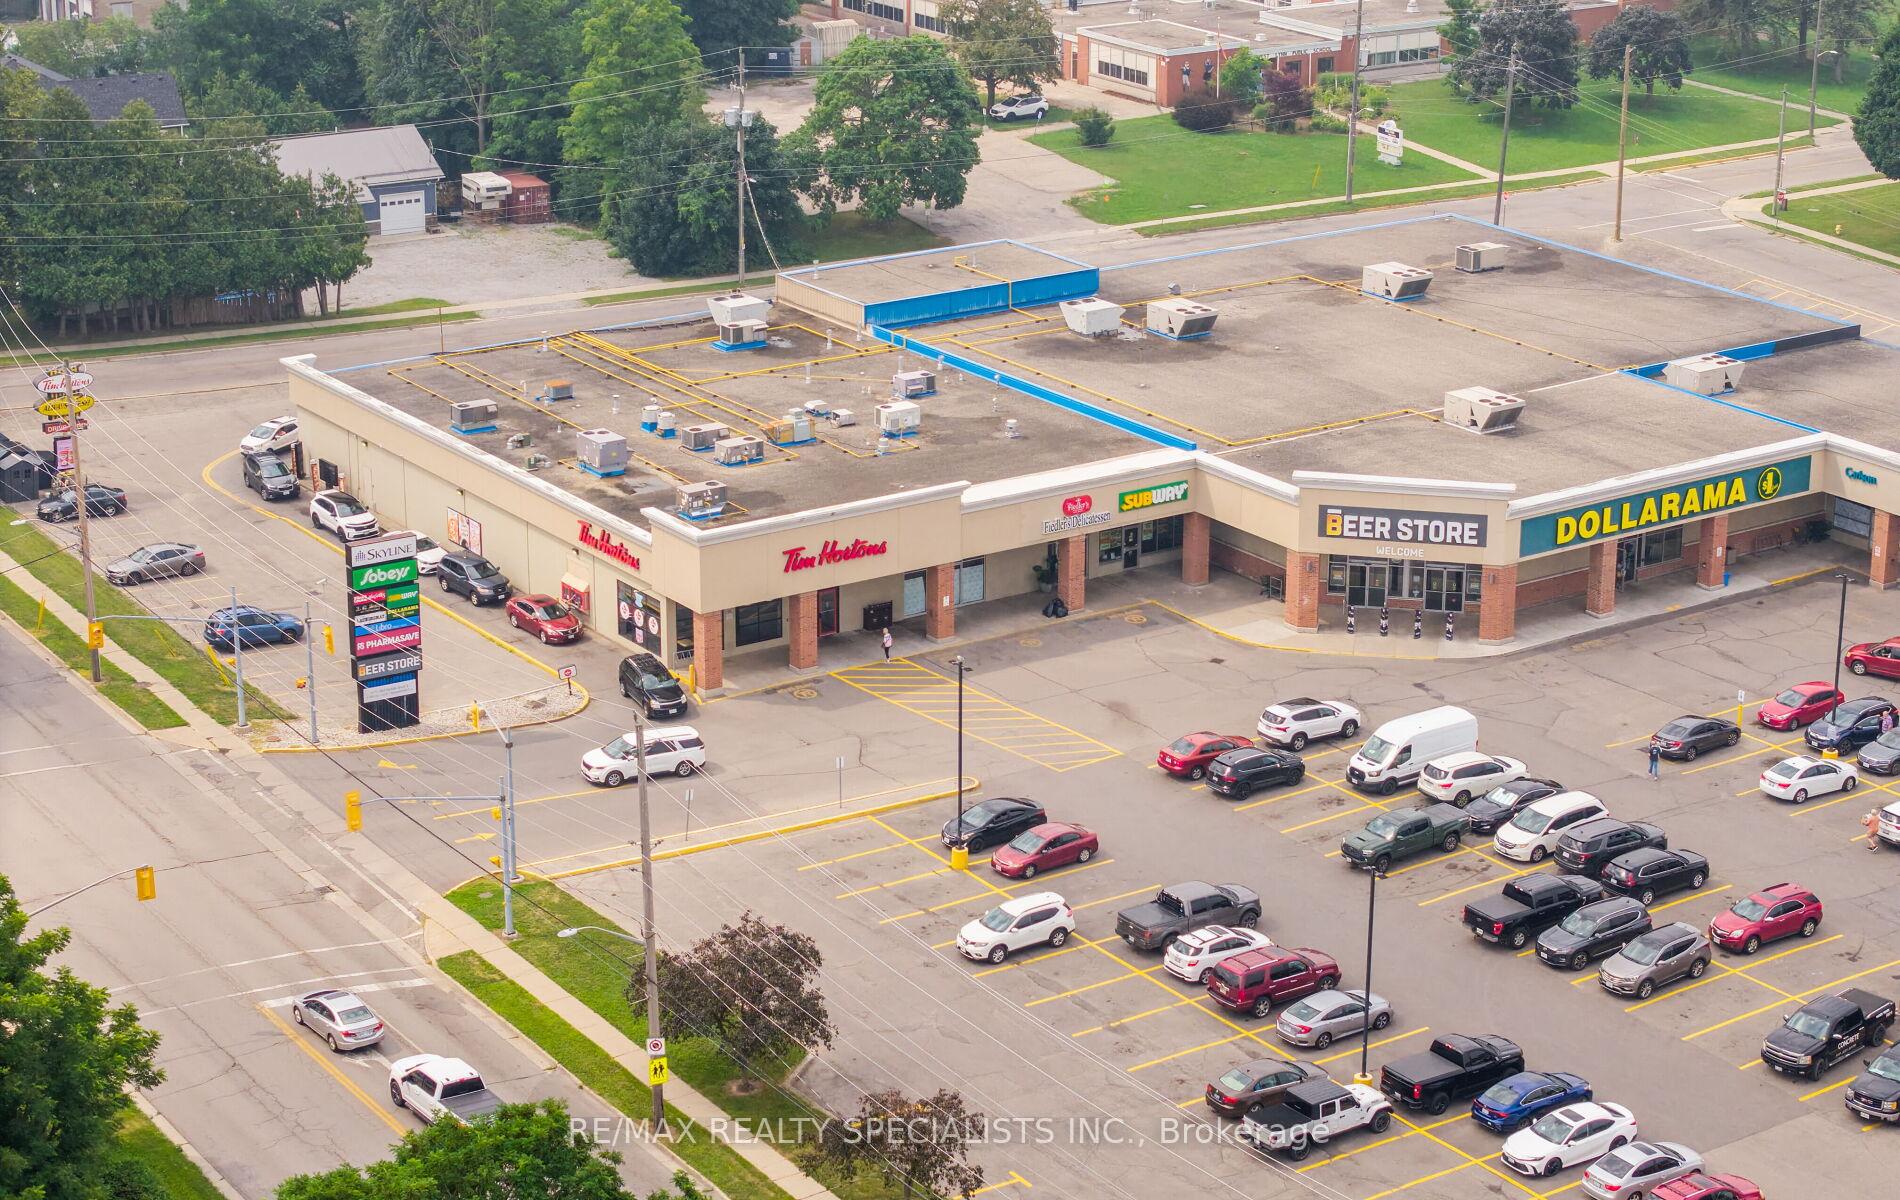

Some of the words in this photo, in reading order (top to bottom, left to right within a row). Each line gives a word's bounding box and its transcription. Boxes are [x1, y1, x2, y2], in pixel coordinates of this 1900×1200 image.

[1120, 482, 1188, 511] SUBWAY
[1556, 477, 1747, 545] DOLLARAMA
[1044, 516, 1071, 533] Fiedler's
[1072, 511, 1111, 528] Delicatessen
[1326, 508, 1391, 540] BEER
[1396, 518, 1479, 545] STORE
[577, 519, 598, 549] Tim
[599, 529, 640, 570] Hortons
[1376, 545, 1424, 558] WELCOME
[782, 546, 816, 573] Tim
[818, 538, 888, 566] Hortons
[360, 566, 410, 586] Sobeys
[375, 623, 392, 632] Libro
[366, 632, 420, 649] PHARMASAVE
[387, 656, 420, 671] STORE
[1837, 1033, 1860, 1049] CONCRETE
